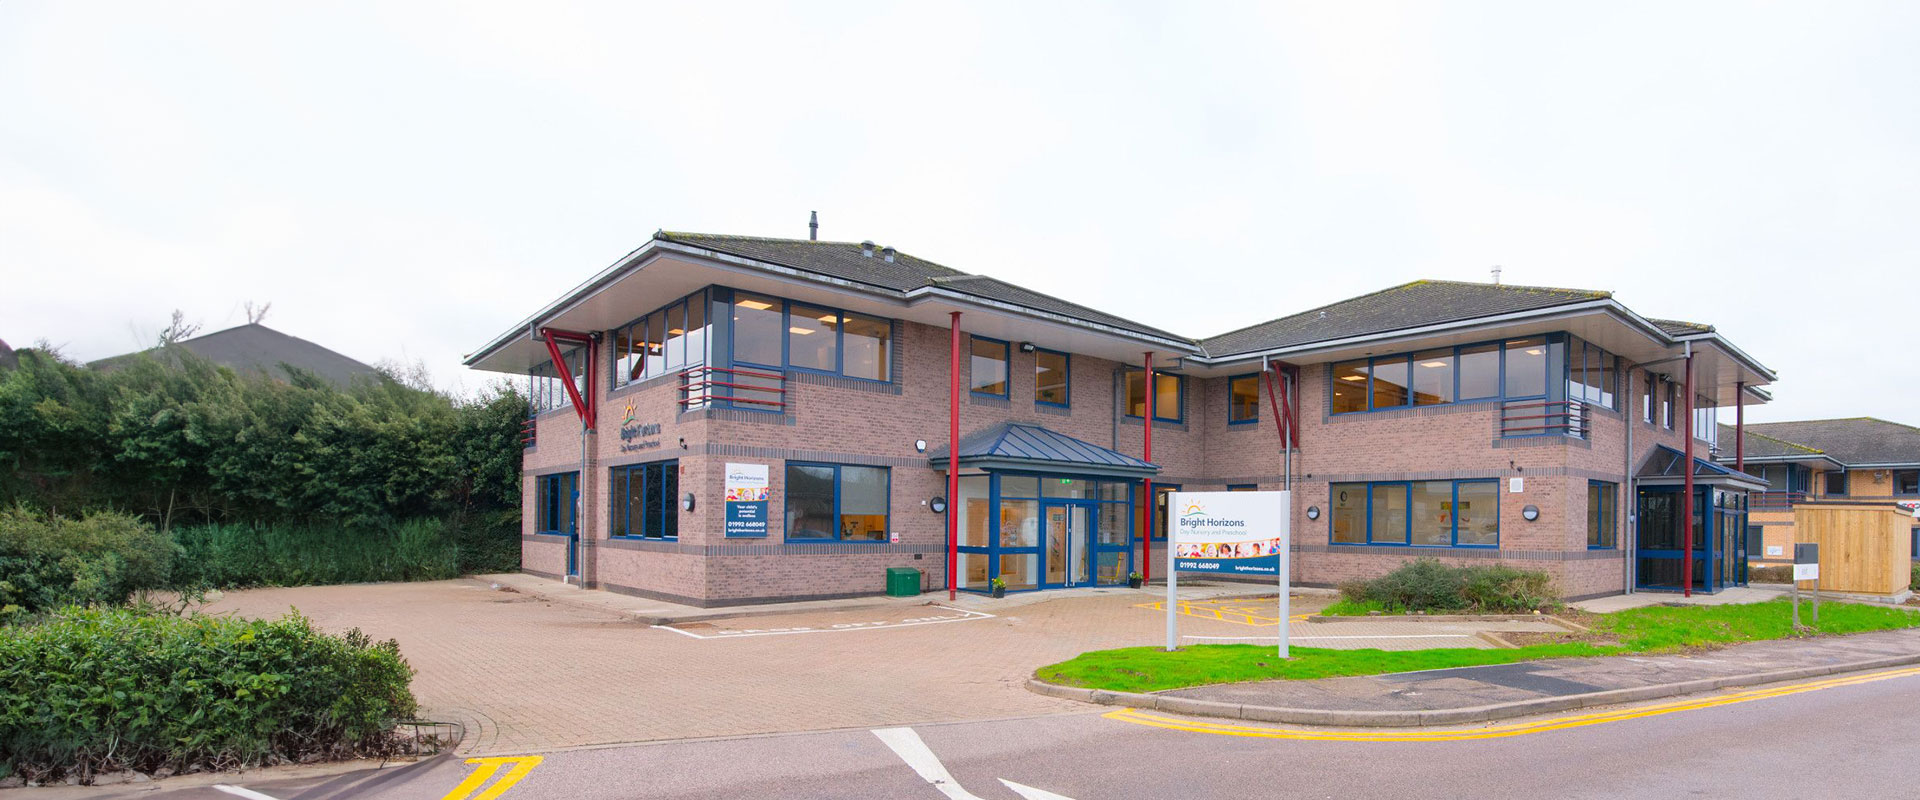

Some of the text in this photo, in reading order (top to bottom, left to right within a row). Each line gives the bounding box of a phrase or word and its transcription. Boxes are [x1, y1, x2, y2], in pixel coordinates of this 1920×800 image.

[1180, 517, 1245, 528] Bright Horizons
[1198, 562, 1220, 570] 668049
